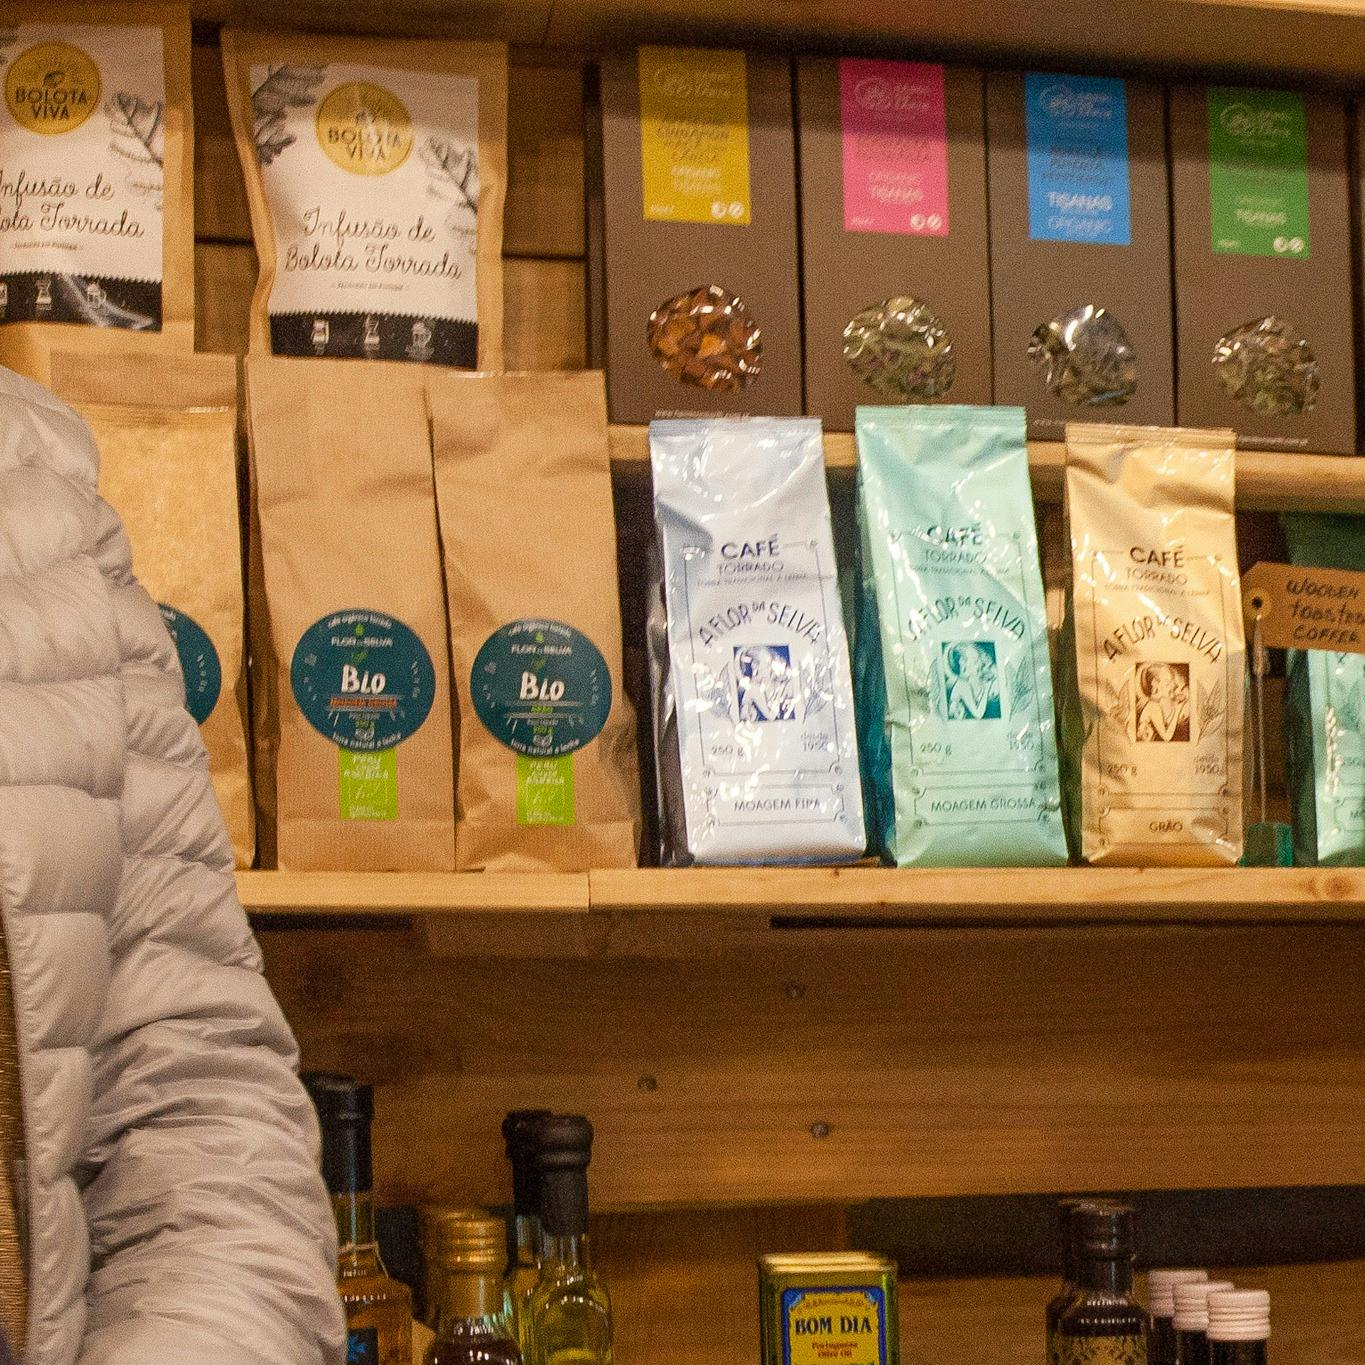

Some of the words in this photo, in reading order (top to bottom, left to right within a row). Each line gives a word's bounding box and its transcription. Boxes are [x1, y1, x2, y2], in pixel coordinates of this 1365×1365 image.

[15, 88, 87, 104] BOLOTA
[32, 103, 70, 120] VIVA
[85, 172, 114, 199] de
[303, 206, 400, 247] Infusão
[407, 215, 436, 242] de
[284, 243, 360, 273] Bolota
[720, 533, 781, 561] CAFÉ
[1128, 545, 1186, 568] CAFÉ
[766, 600, 823, 645] SELVA
[972, 597, 1025, 641] SELVA
[1112, 618, 1155, 650] FLOR
[1170, 617, 1223, 664] SELVA
[734, 798, 790, 812] MOAGEM
[931, 799, 987, 813] MOAGEM
[990, 797, 1038, 812] GROSSA
[1148, 819, 1184, 834] GRÃO
[795, 1316, 833, 1336] BOM
[839, 1315, 873, 1334] DIA
